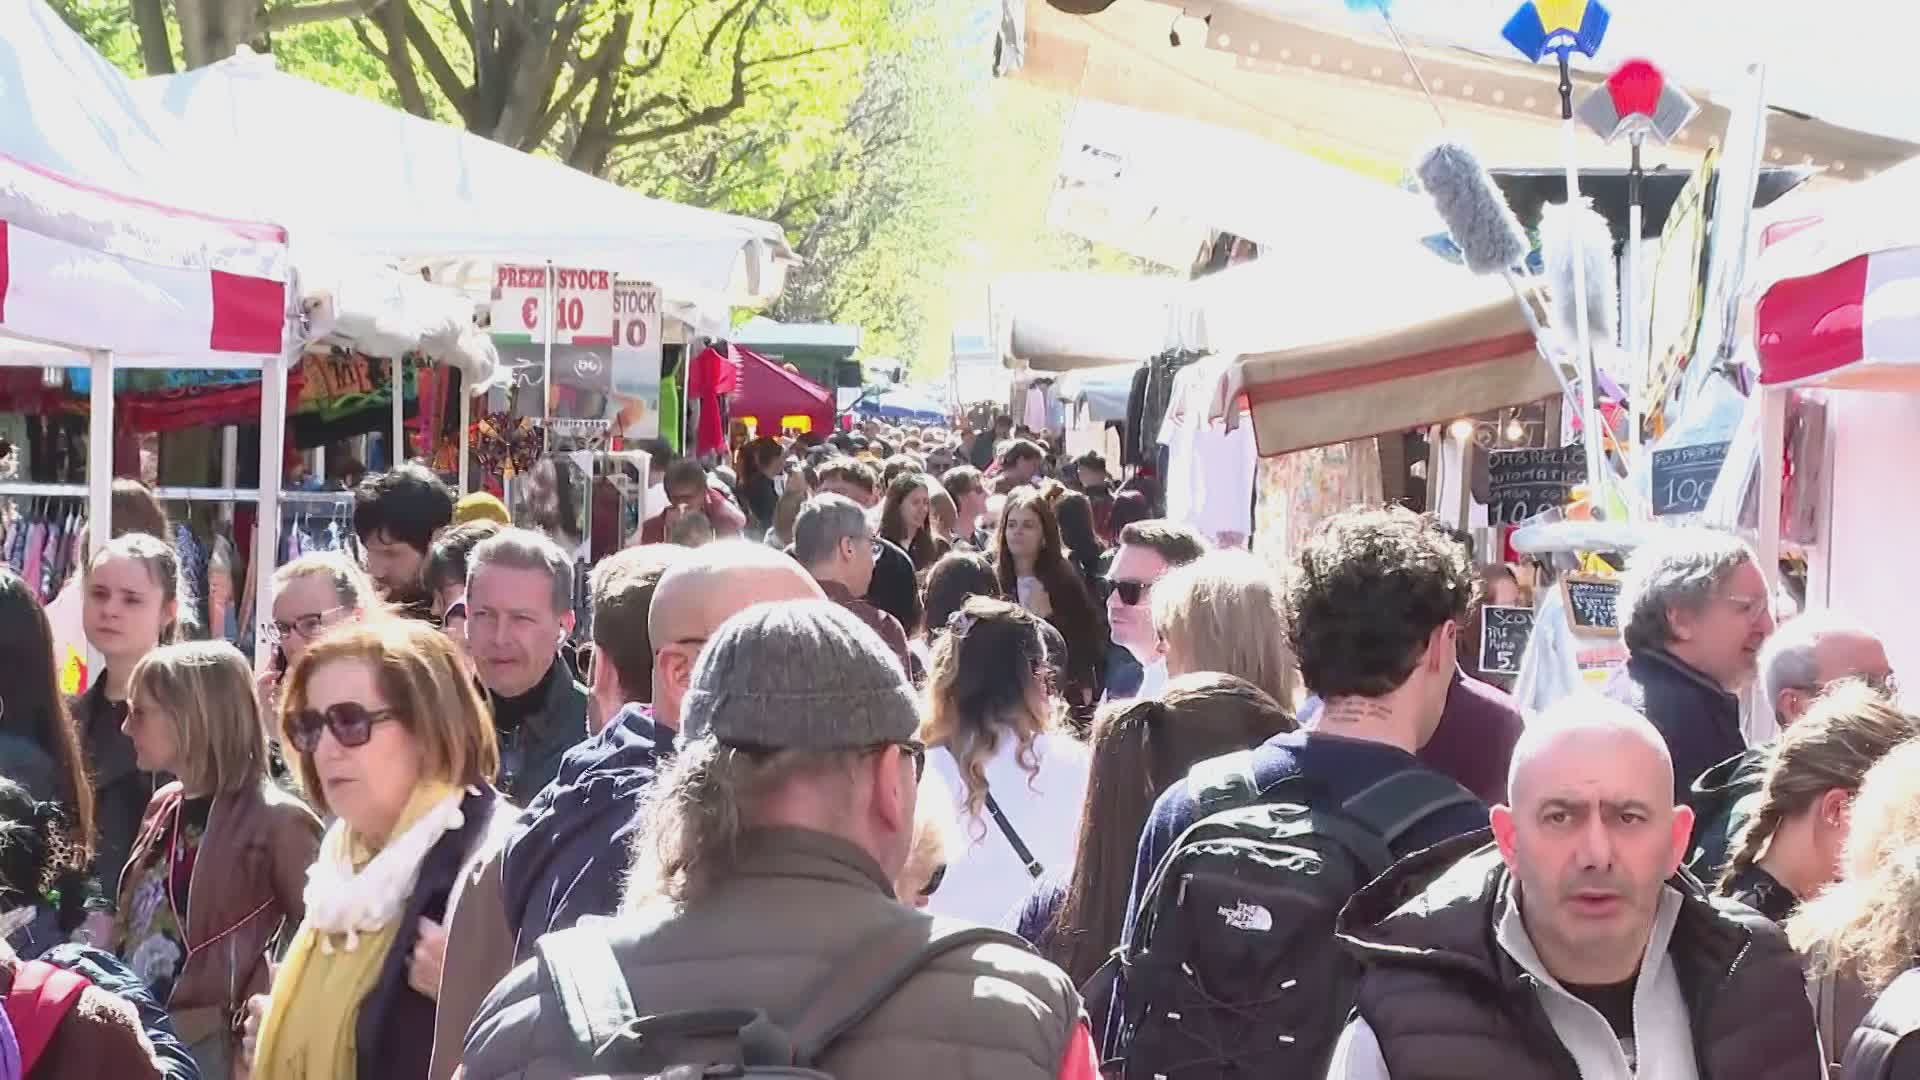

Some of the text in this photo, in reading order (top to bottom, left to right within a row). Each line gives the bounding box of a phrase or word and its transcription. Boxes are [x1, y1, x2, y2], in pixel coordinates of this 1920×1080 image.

[497, 267, 609, 290] PREZZ STOCK
[522, 297, 584, 331] € 10
[613, 290, 656, 314] STOCK
